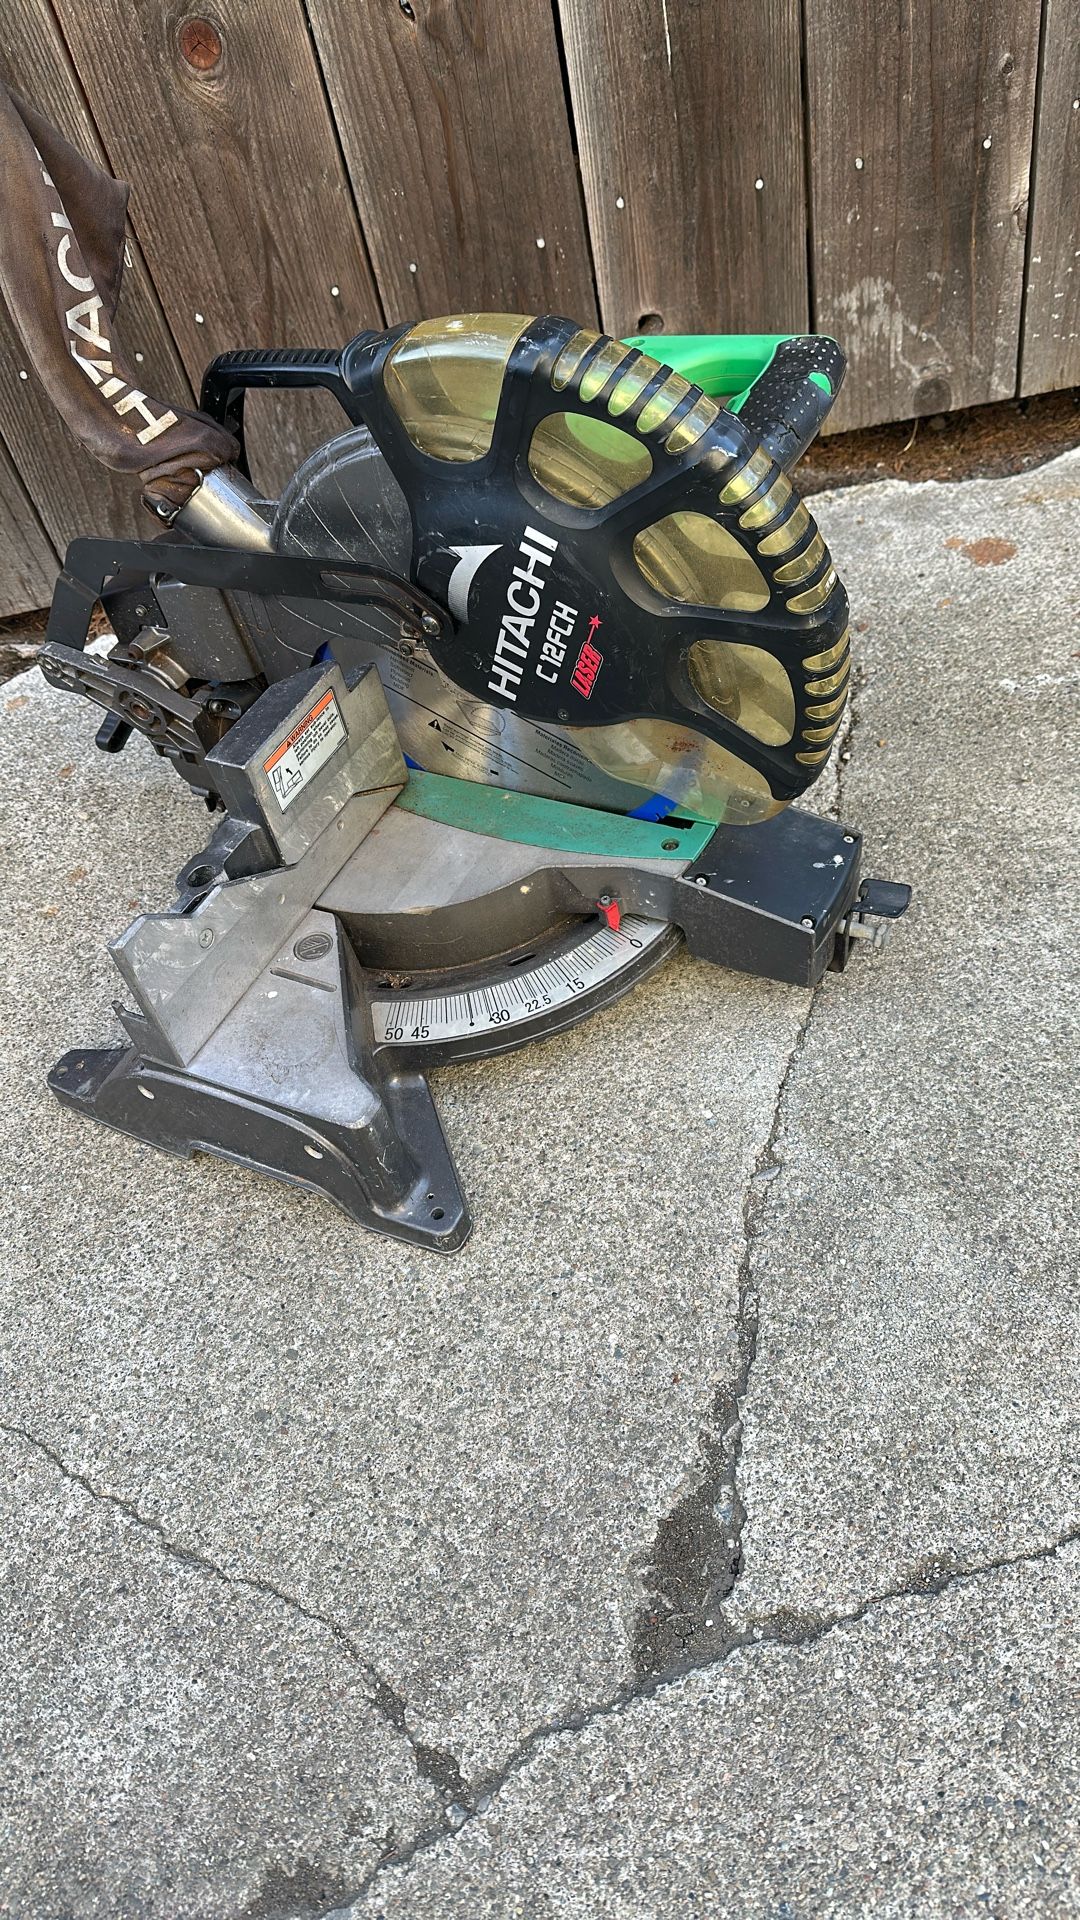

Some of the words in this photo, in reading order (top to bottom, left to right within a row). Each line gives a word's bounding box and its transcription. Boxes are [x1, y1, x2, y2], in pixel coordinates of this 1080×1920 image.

[33, 146, 178, 445] HITAC
[487, 525, 559, 702] HITACHI
[539, 600, 579, 668] 12FCH
[535, 663, 559, 684] C
[571, 642, 603, 698] LASER
[290, 714, 313, 741] WARNING
[384, 1027, 403, 1041] 50
[410, 1025, 430, 1040] 45
[492, 1009, 510, 1025] 30
[524, 995, 552, 1013] 22.5
[565, 977, 585, 994] 15
[630, 938, 643, 949] 0
